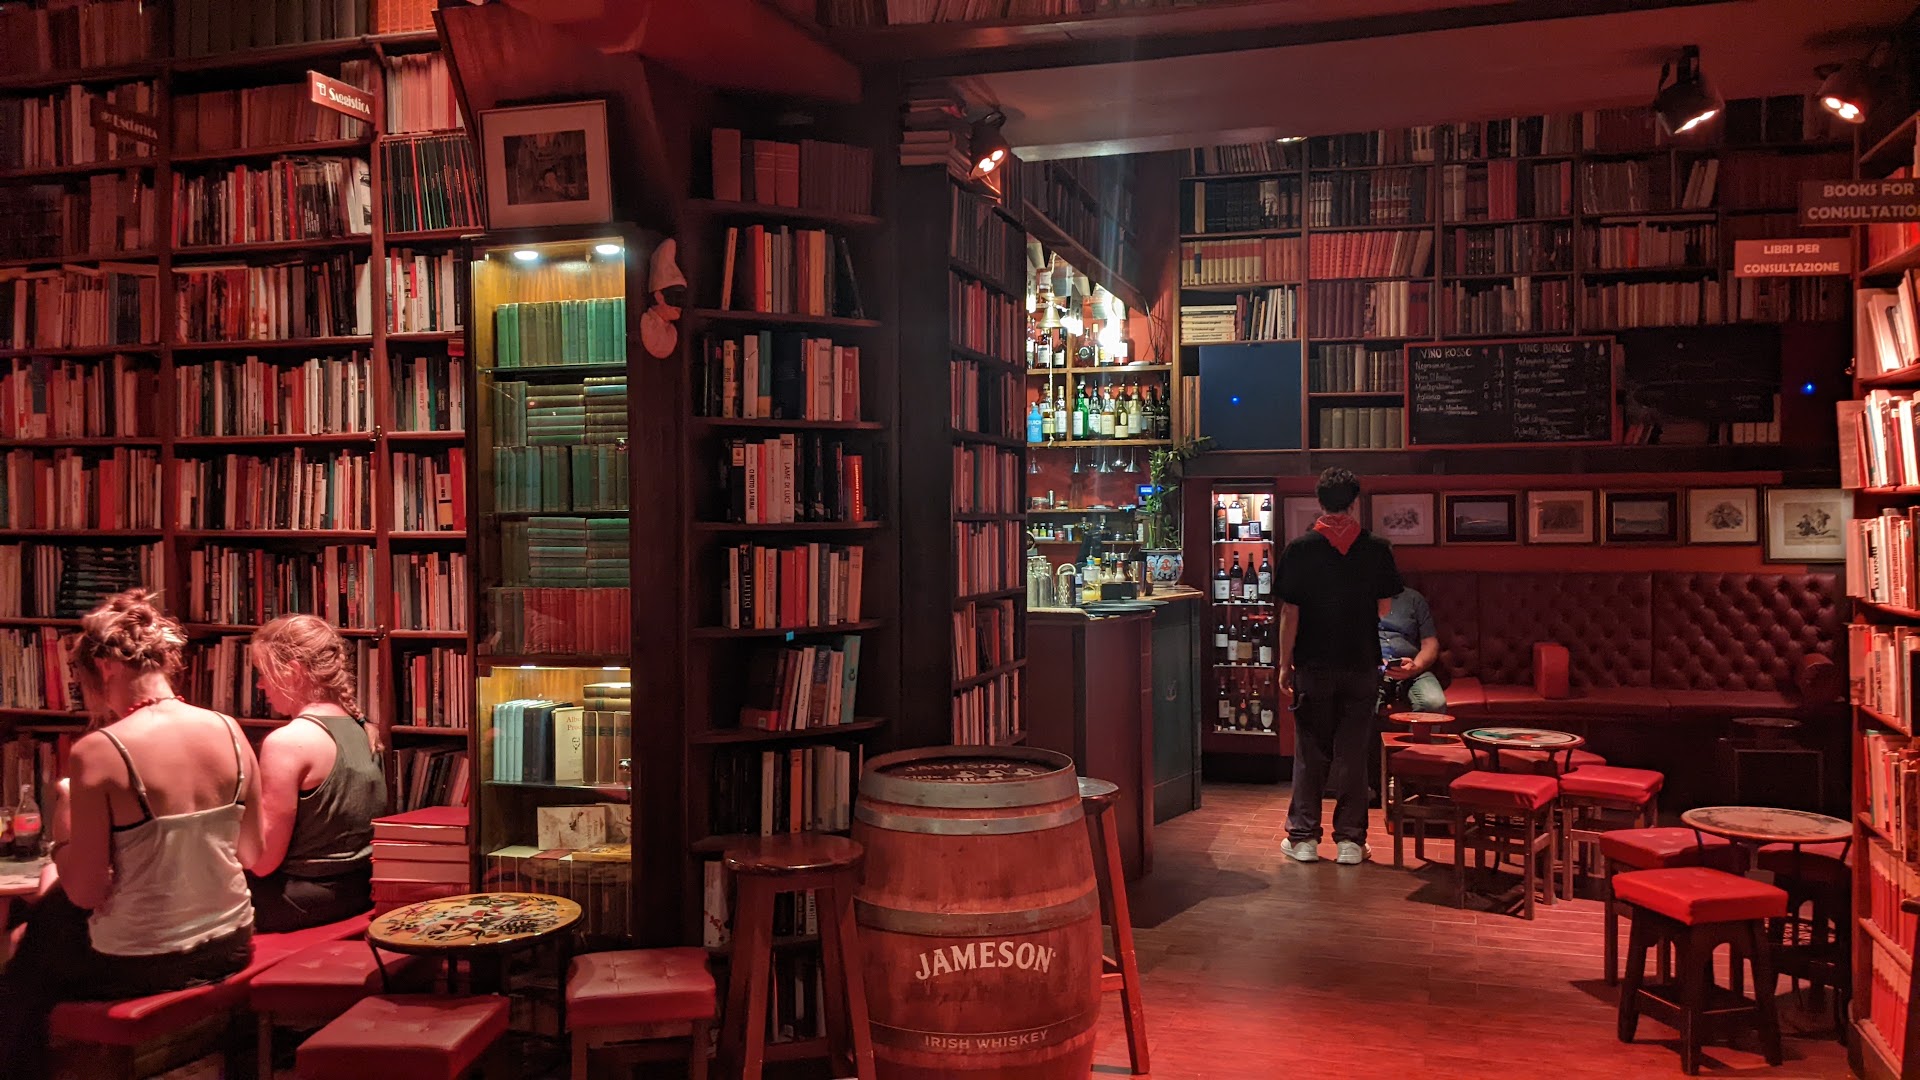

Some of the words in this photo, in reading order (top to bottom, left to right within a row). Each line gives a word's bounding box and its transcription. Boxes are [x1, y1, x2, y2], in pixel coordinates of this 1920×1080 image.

[1823, 184, 1877, 197] BOOKS
[1881, 183, 1915, 195] FOR
[1807, 204, 1920, 219] CONSULTATIO
[1763, 245, 1793, 254] LIBRI
[1796, 244, 1820, 253] PER
[1743, 262, 1840, 273] CONSULTAZIONE
[1420, 348, 1442, 359] VINO
[1445, 347, 1472, 358] ROSSO
[784, 481, 791, 489] DI
[905, 762, 1011, 772] JAMESON
[915, 941, 1053, 980] JAMESON
[925, 1035, 970, 1049] IRISH
[976, 1029, 1049, 1049] WHISKEY
